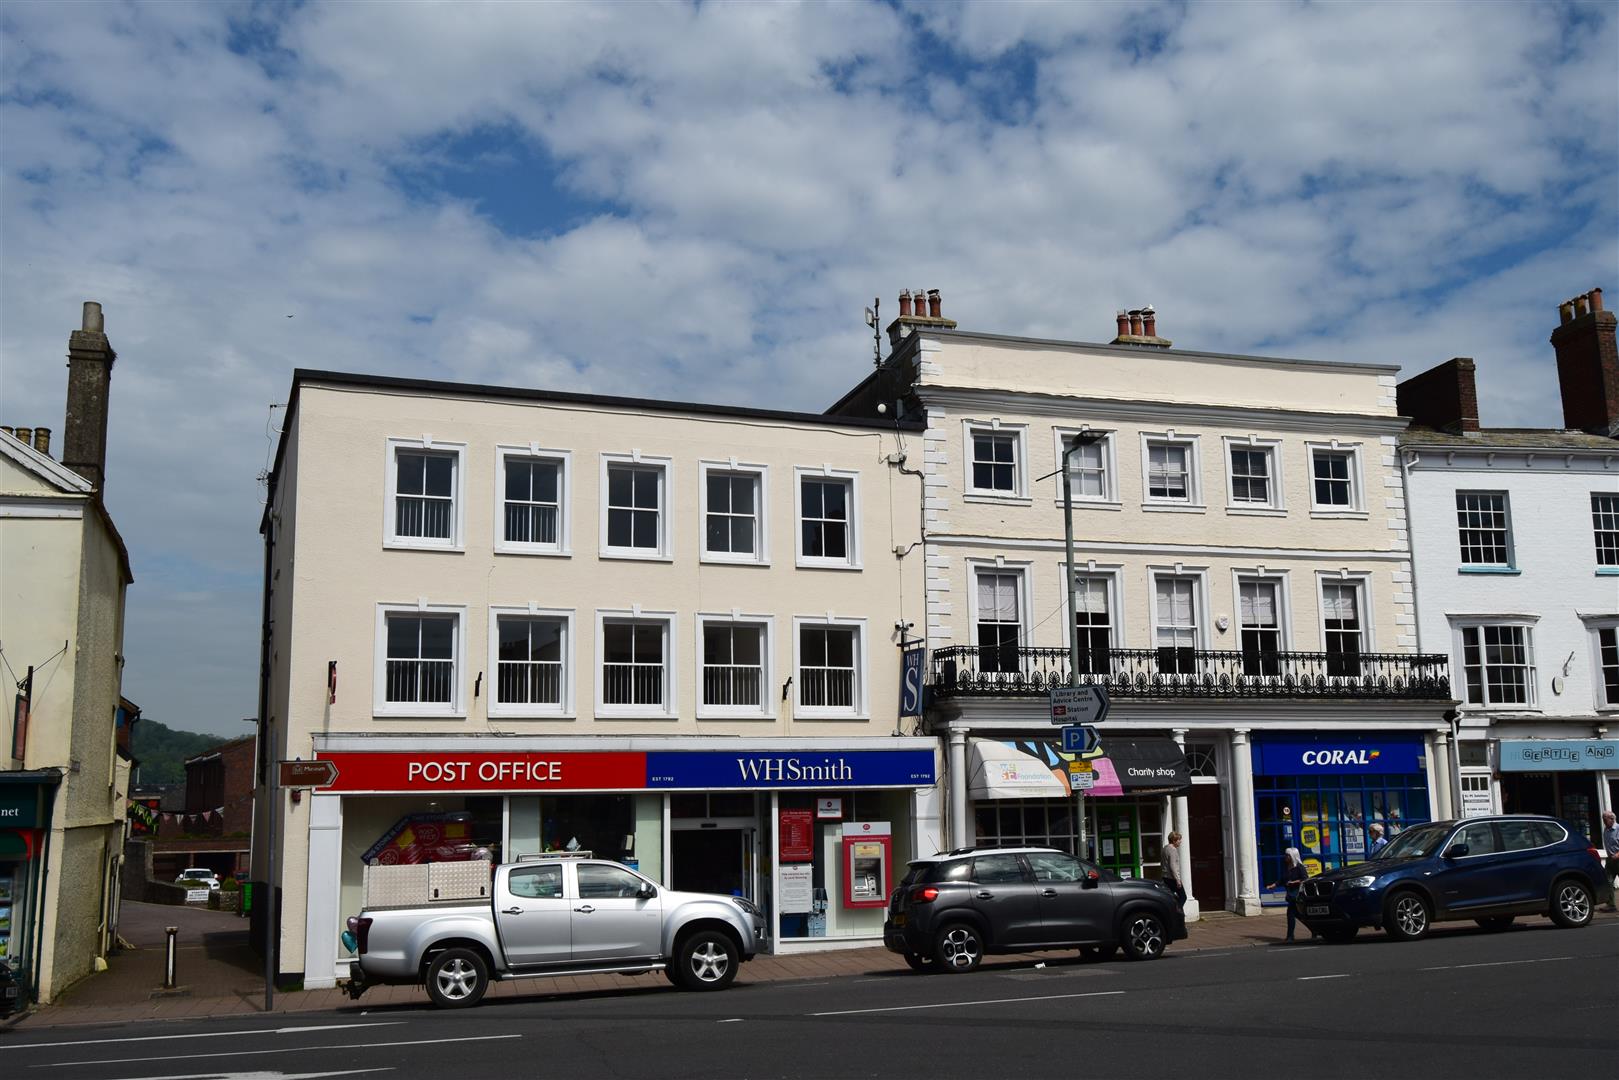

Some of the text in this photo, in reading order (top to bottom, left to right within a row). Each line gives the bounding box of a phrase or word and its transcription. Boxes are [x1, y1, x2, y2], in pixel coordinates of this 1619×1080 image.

[906, 653, 919, 666] WH
[904, 667, 918, 711] S
[1071, 732, 1080, 748] P
[1302, 750, 1369, 765] CORAL
[1524, 746, 1614, 761] GERTIE AND
[408, 761, 562, 781] POST OFFICE
[737, 758, 853, 781] WHSmith
[1127, 766, 1176, 778] Charity shop
[1, 808, 19, 816] net
